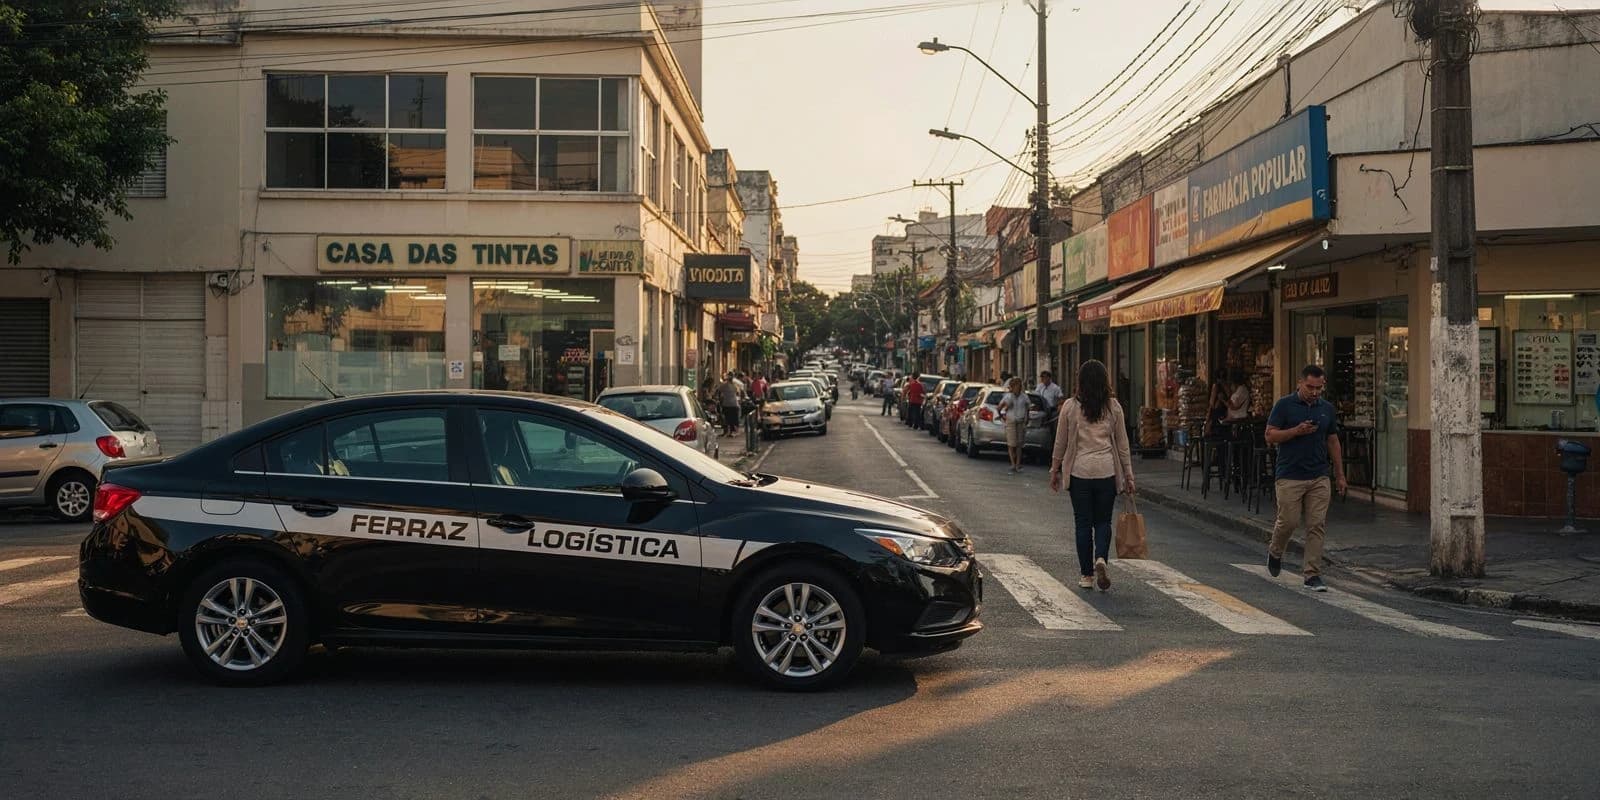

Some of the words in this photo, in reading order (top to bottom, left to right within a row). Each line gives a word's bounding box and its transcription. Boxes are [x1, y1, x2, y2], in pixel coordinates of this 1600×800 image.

[1203, 170, 1250, 219] FARMÁCIA
[1251, 144, 1307, 199] POPULAR
[326, 242, 394, 264] CASA
[408, 243, 457, 265] DAS
[472, 243, 558, 265] TINTAS
[350, 514, 468, 541] FERRAZ
[527, 528, 680, 559] LOGÍSTICA
